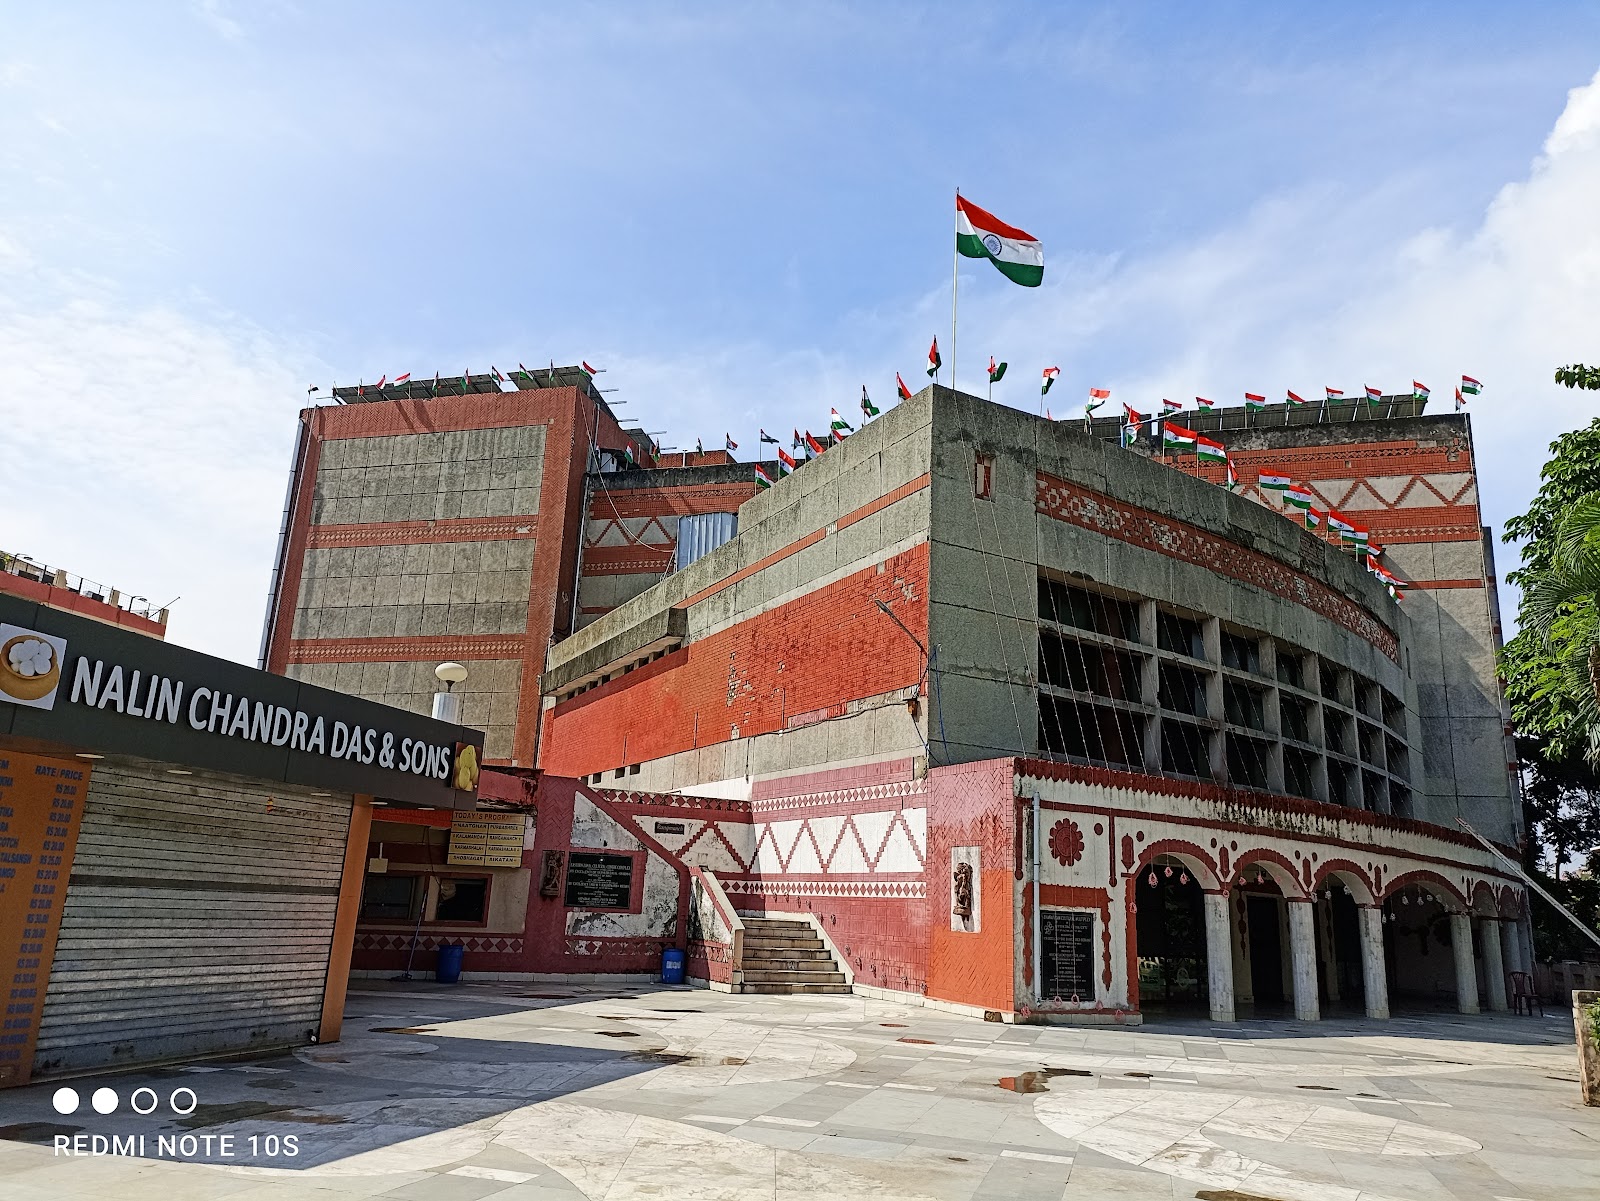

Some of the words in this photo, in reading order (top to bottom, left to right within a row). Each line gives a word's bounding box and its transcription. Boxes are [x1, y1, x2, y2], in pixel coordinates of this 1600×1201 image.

[70, 655, 184, 725] NALIN
[188, 686, 325, 755] CHANDRA
[330, 720, 377, 765] DAS
[378, 731, 395, 770] &
[398, 737, 451, 780] SONS
[55, 783, 63, 794] RS
[52, 798, 60, 808] RS
[49, 812, 57, 822] RS
[454, 811, 483, 820] TODAY'S
[46, 826, 54, 836] RS
[43, 840, 50, 851] RS
[39, 854, 47, 865] RS
[36, 869, 44, 879] RS
[33, 883, 41, 894] RS
